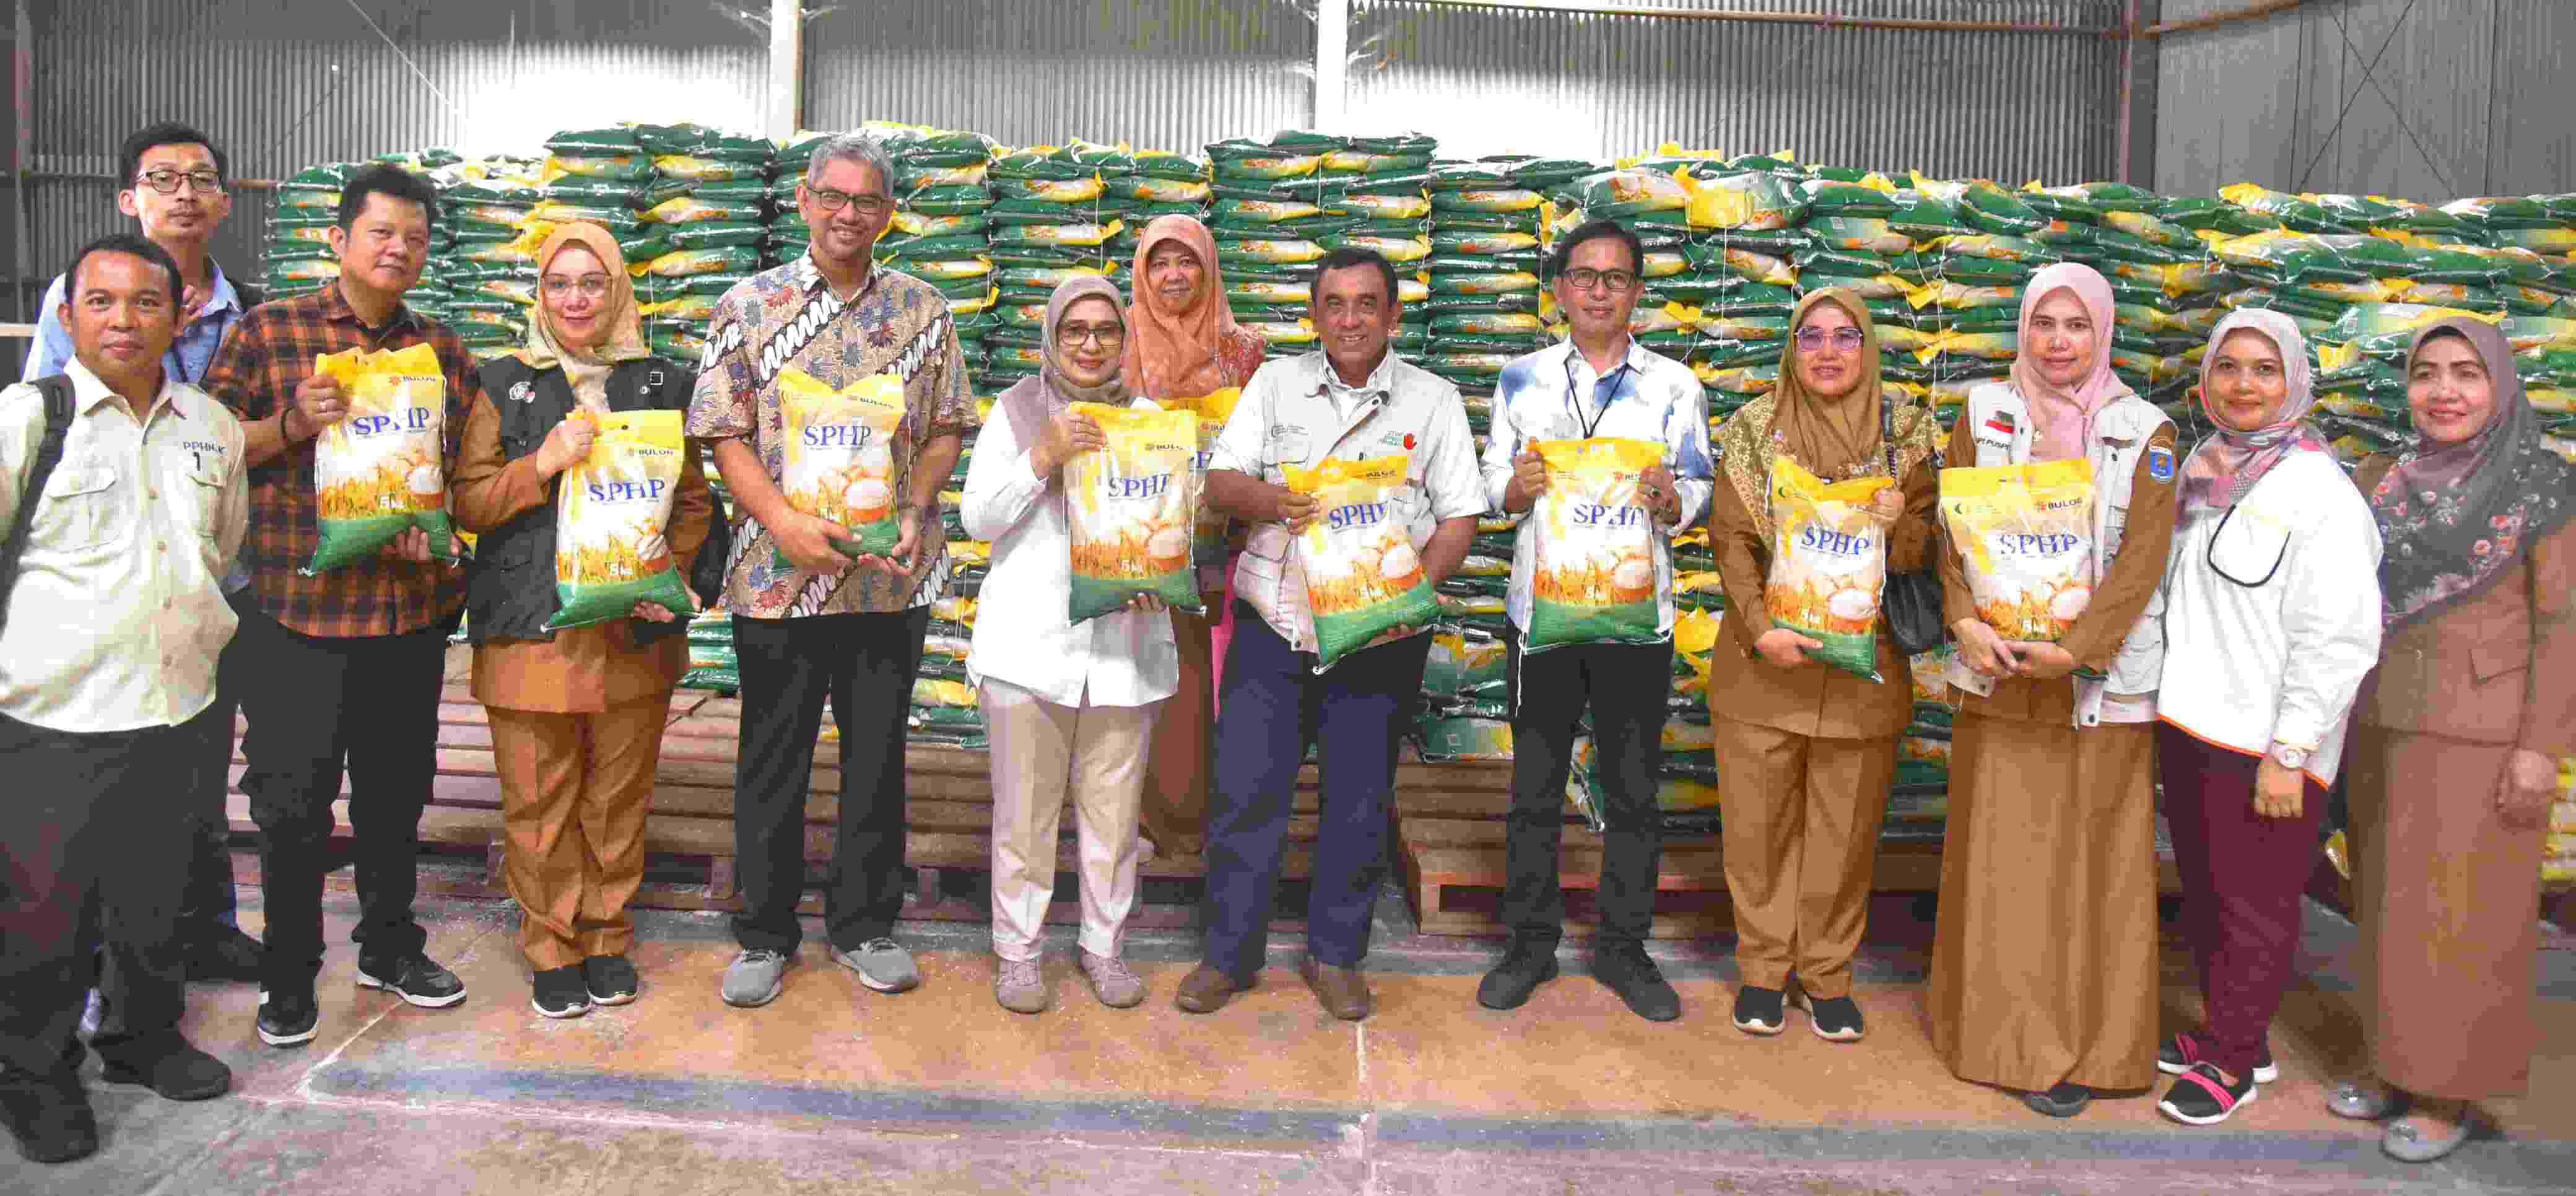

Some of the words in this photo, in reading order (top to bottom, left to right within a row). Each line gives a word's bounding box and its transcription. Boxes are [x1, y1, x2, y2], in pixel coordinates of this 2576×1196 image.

[804, 426, 872, 446] SPHP
[589, 479, 665, 501] SPHP
[1801, 525, 1870, 556] SPHP
[2000, 533, 2078, 555] SPHP
